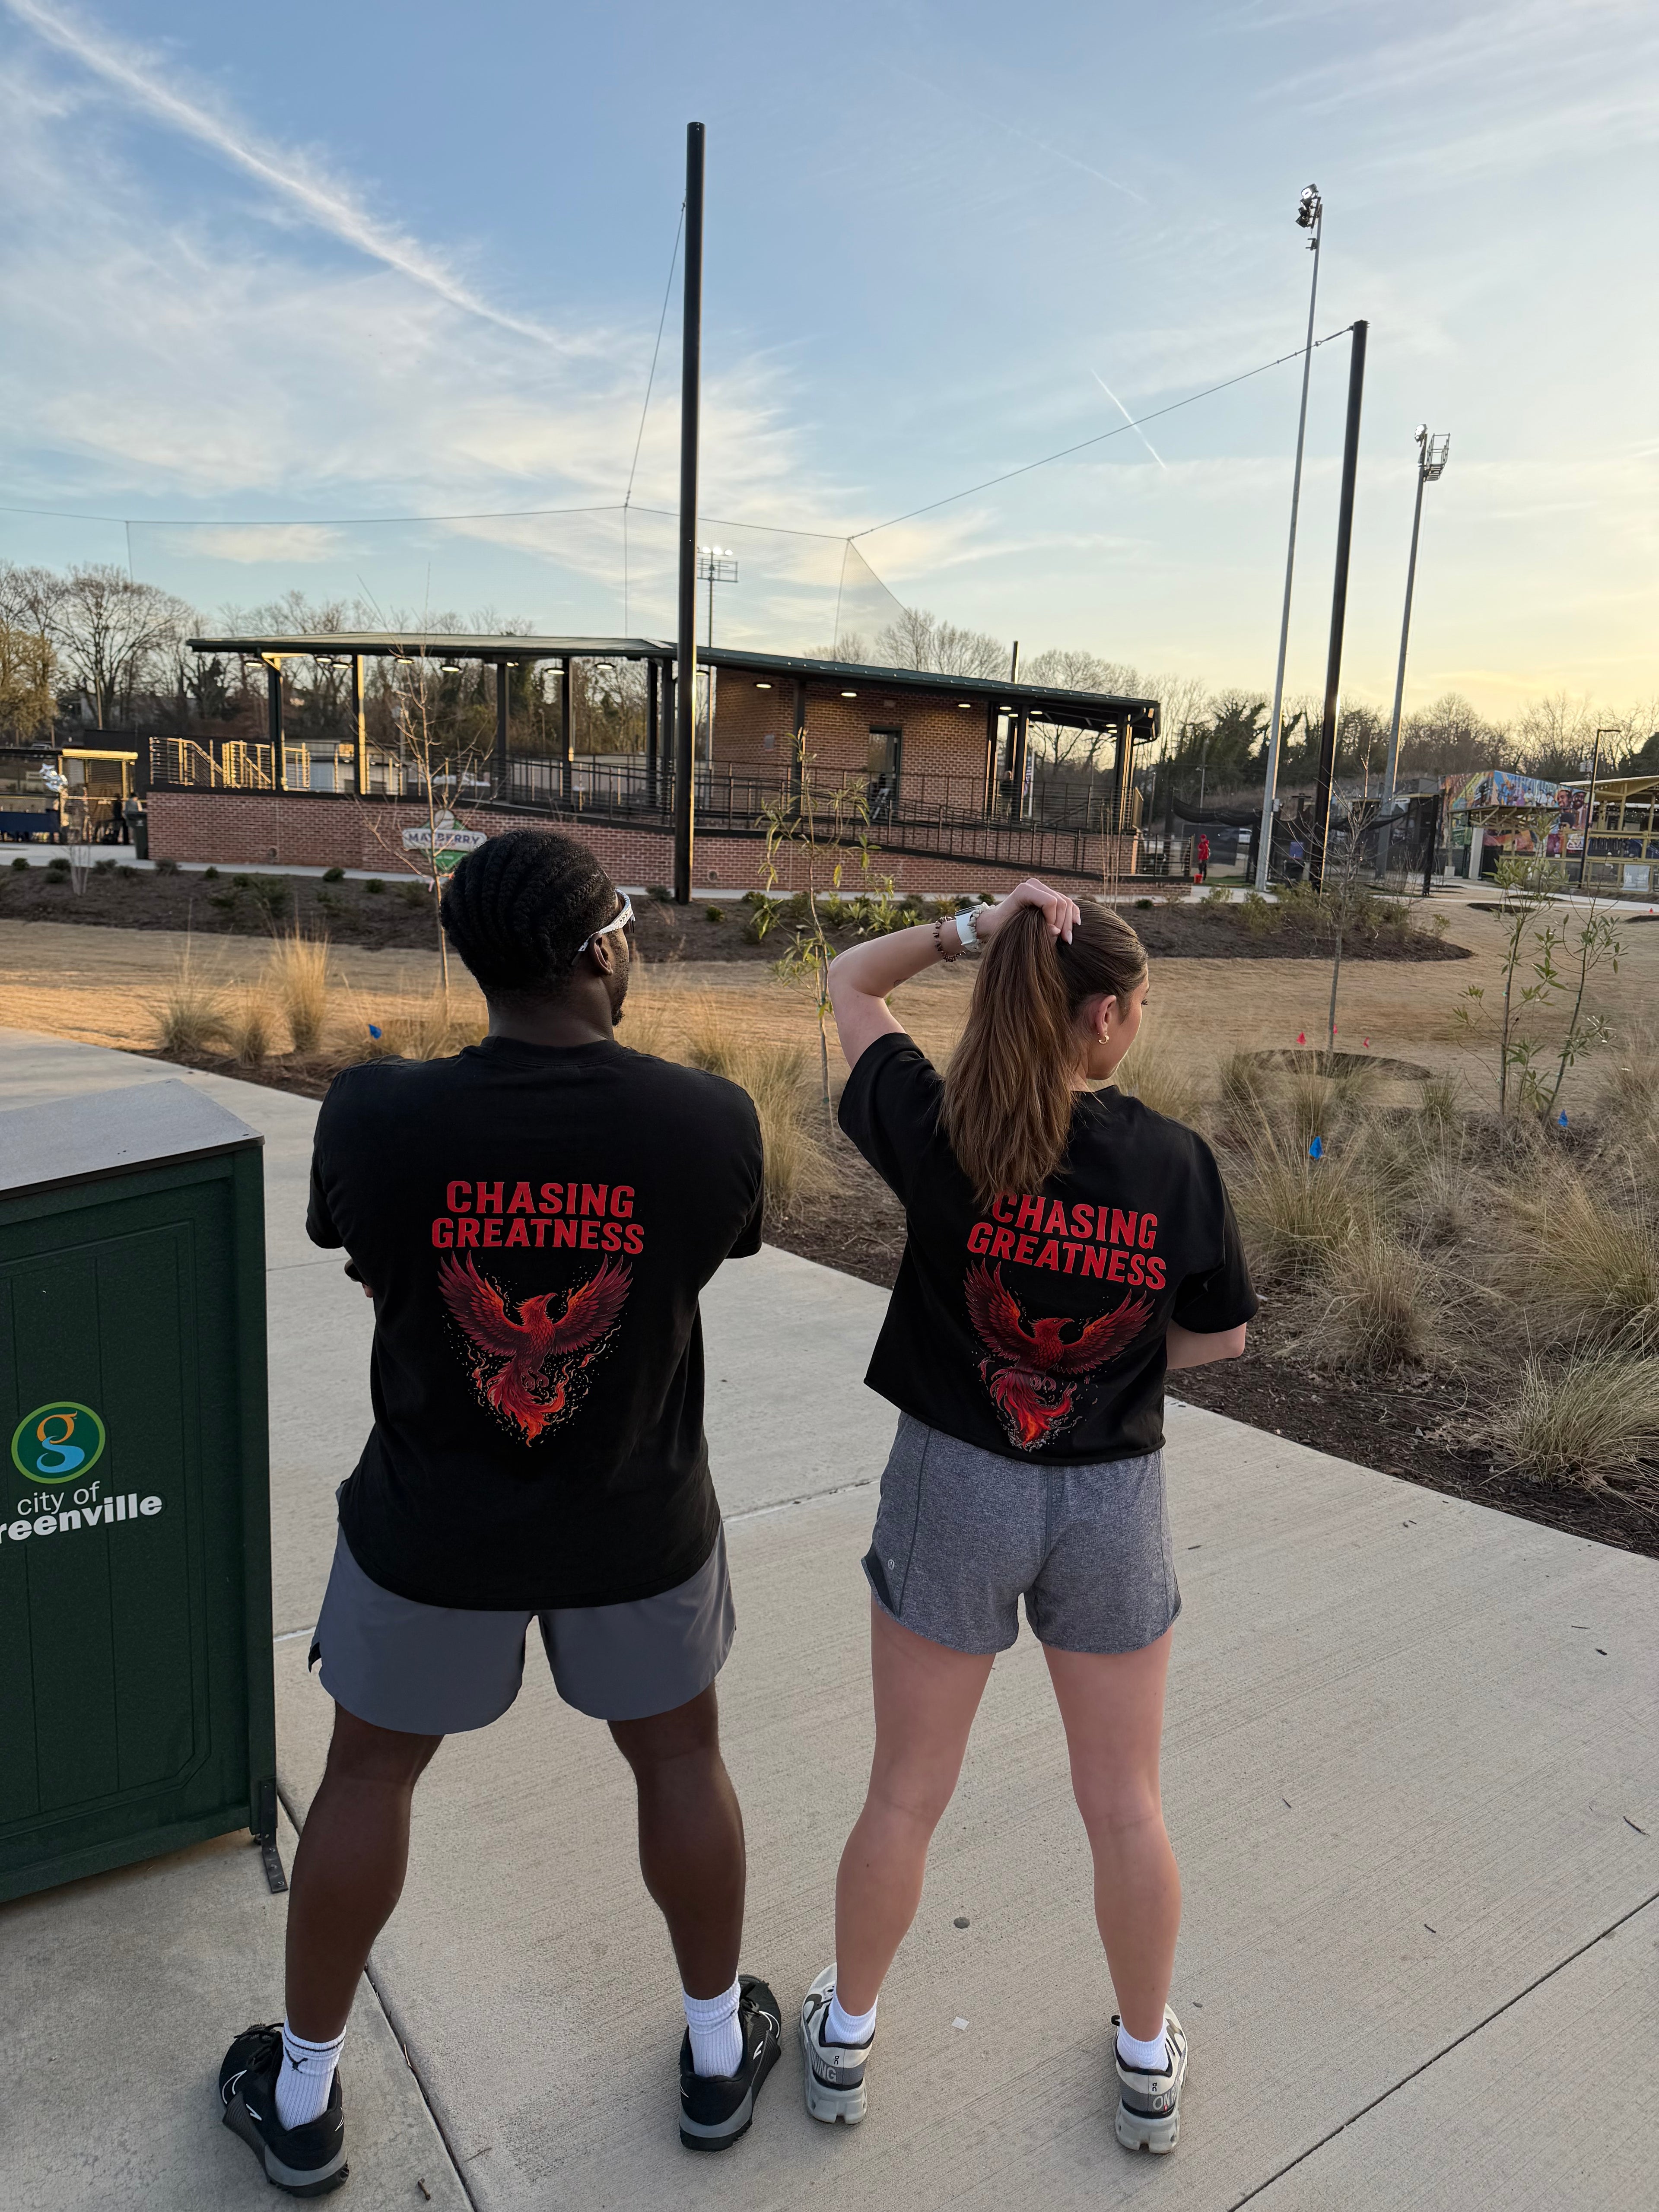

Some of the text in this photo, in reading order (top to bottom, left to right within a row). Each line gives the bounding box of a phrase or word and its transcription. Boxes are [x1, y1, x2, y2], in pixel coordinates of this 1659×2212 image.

[447, 1180, 635, 1218] CHASING
[432, 1217, 644, 1254] GREATNESS
[992, 1191, 1158, 1250] CHASING
[967, 1222, 1166, 1290] GREATNESS
[17, 1481, 100, 1516] city of
